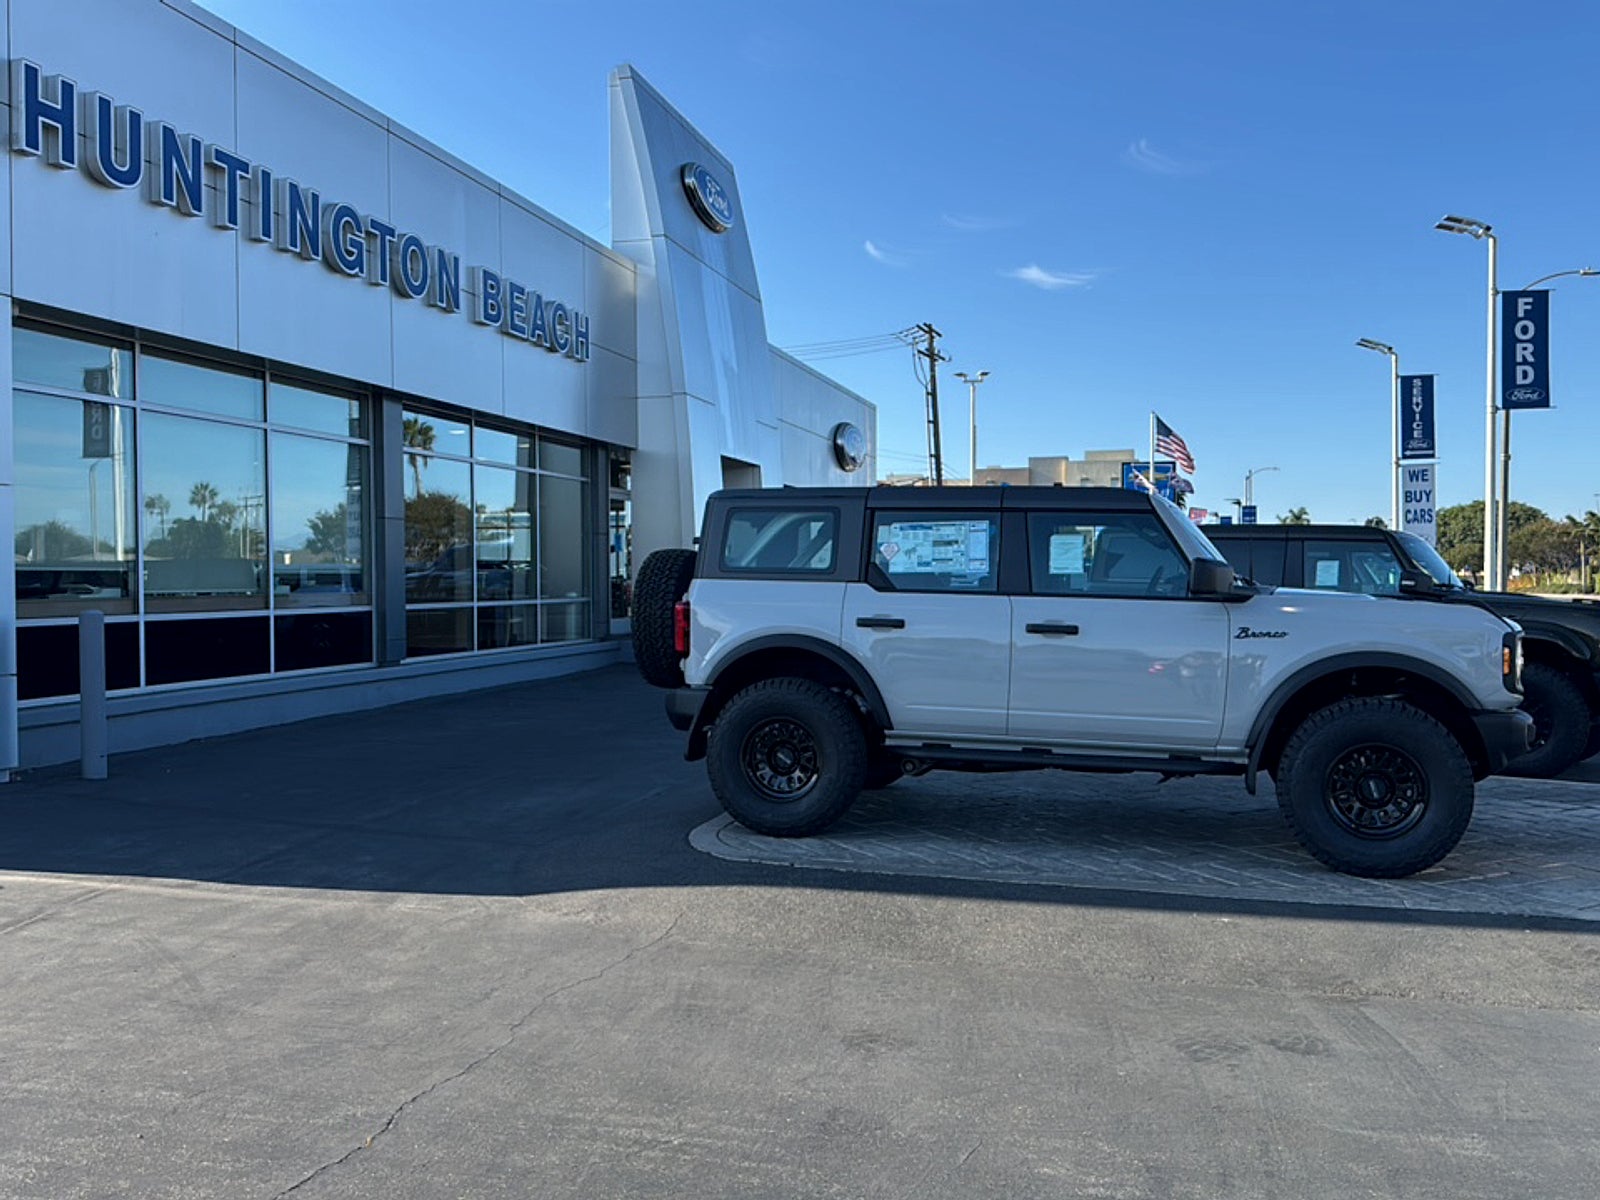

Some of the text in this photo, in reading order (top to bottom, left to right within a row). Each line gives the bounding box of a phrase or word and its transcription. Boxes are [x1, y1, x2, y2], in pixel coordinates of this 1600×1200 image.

[21, 58, 590, 362] HUNTINGTON BEACH
[1514, 297, 1536, 386] FORD
[1511, 390, 1540, 401] Ford
[1408, 468, 1429, 482] WE
[1405, 490, 1432, 503] BUY
[1405, 508, 1434, 524] CARS
[1234, 626, 1289, 640] Bronco
